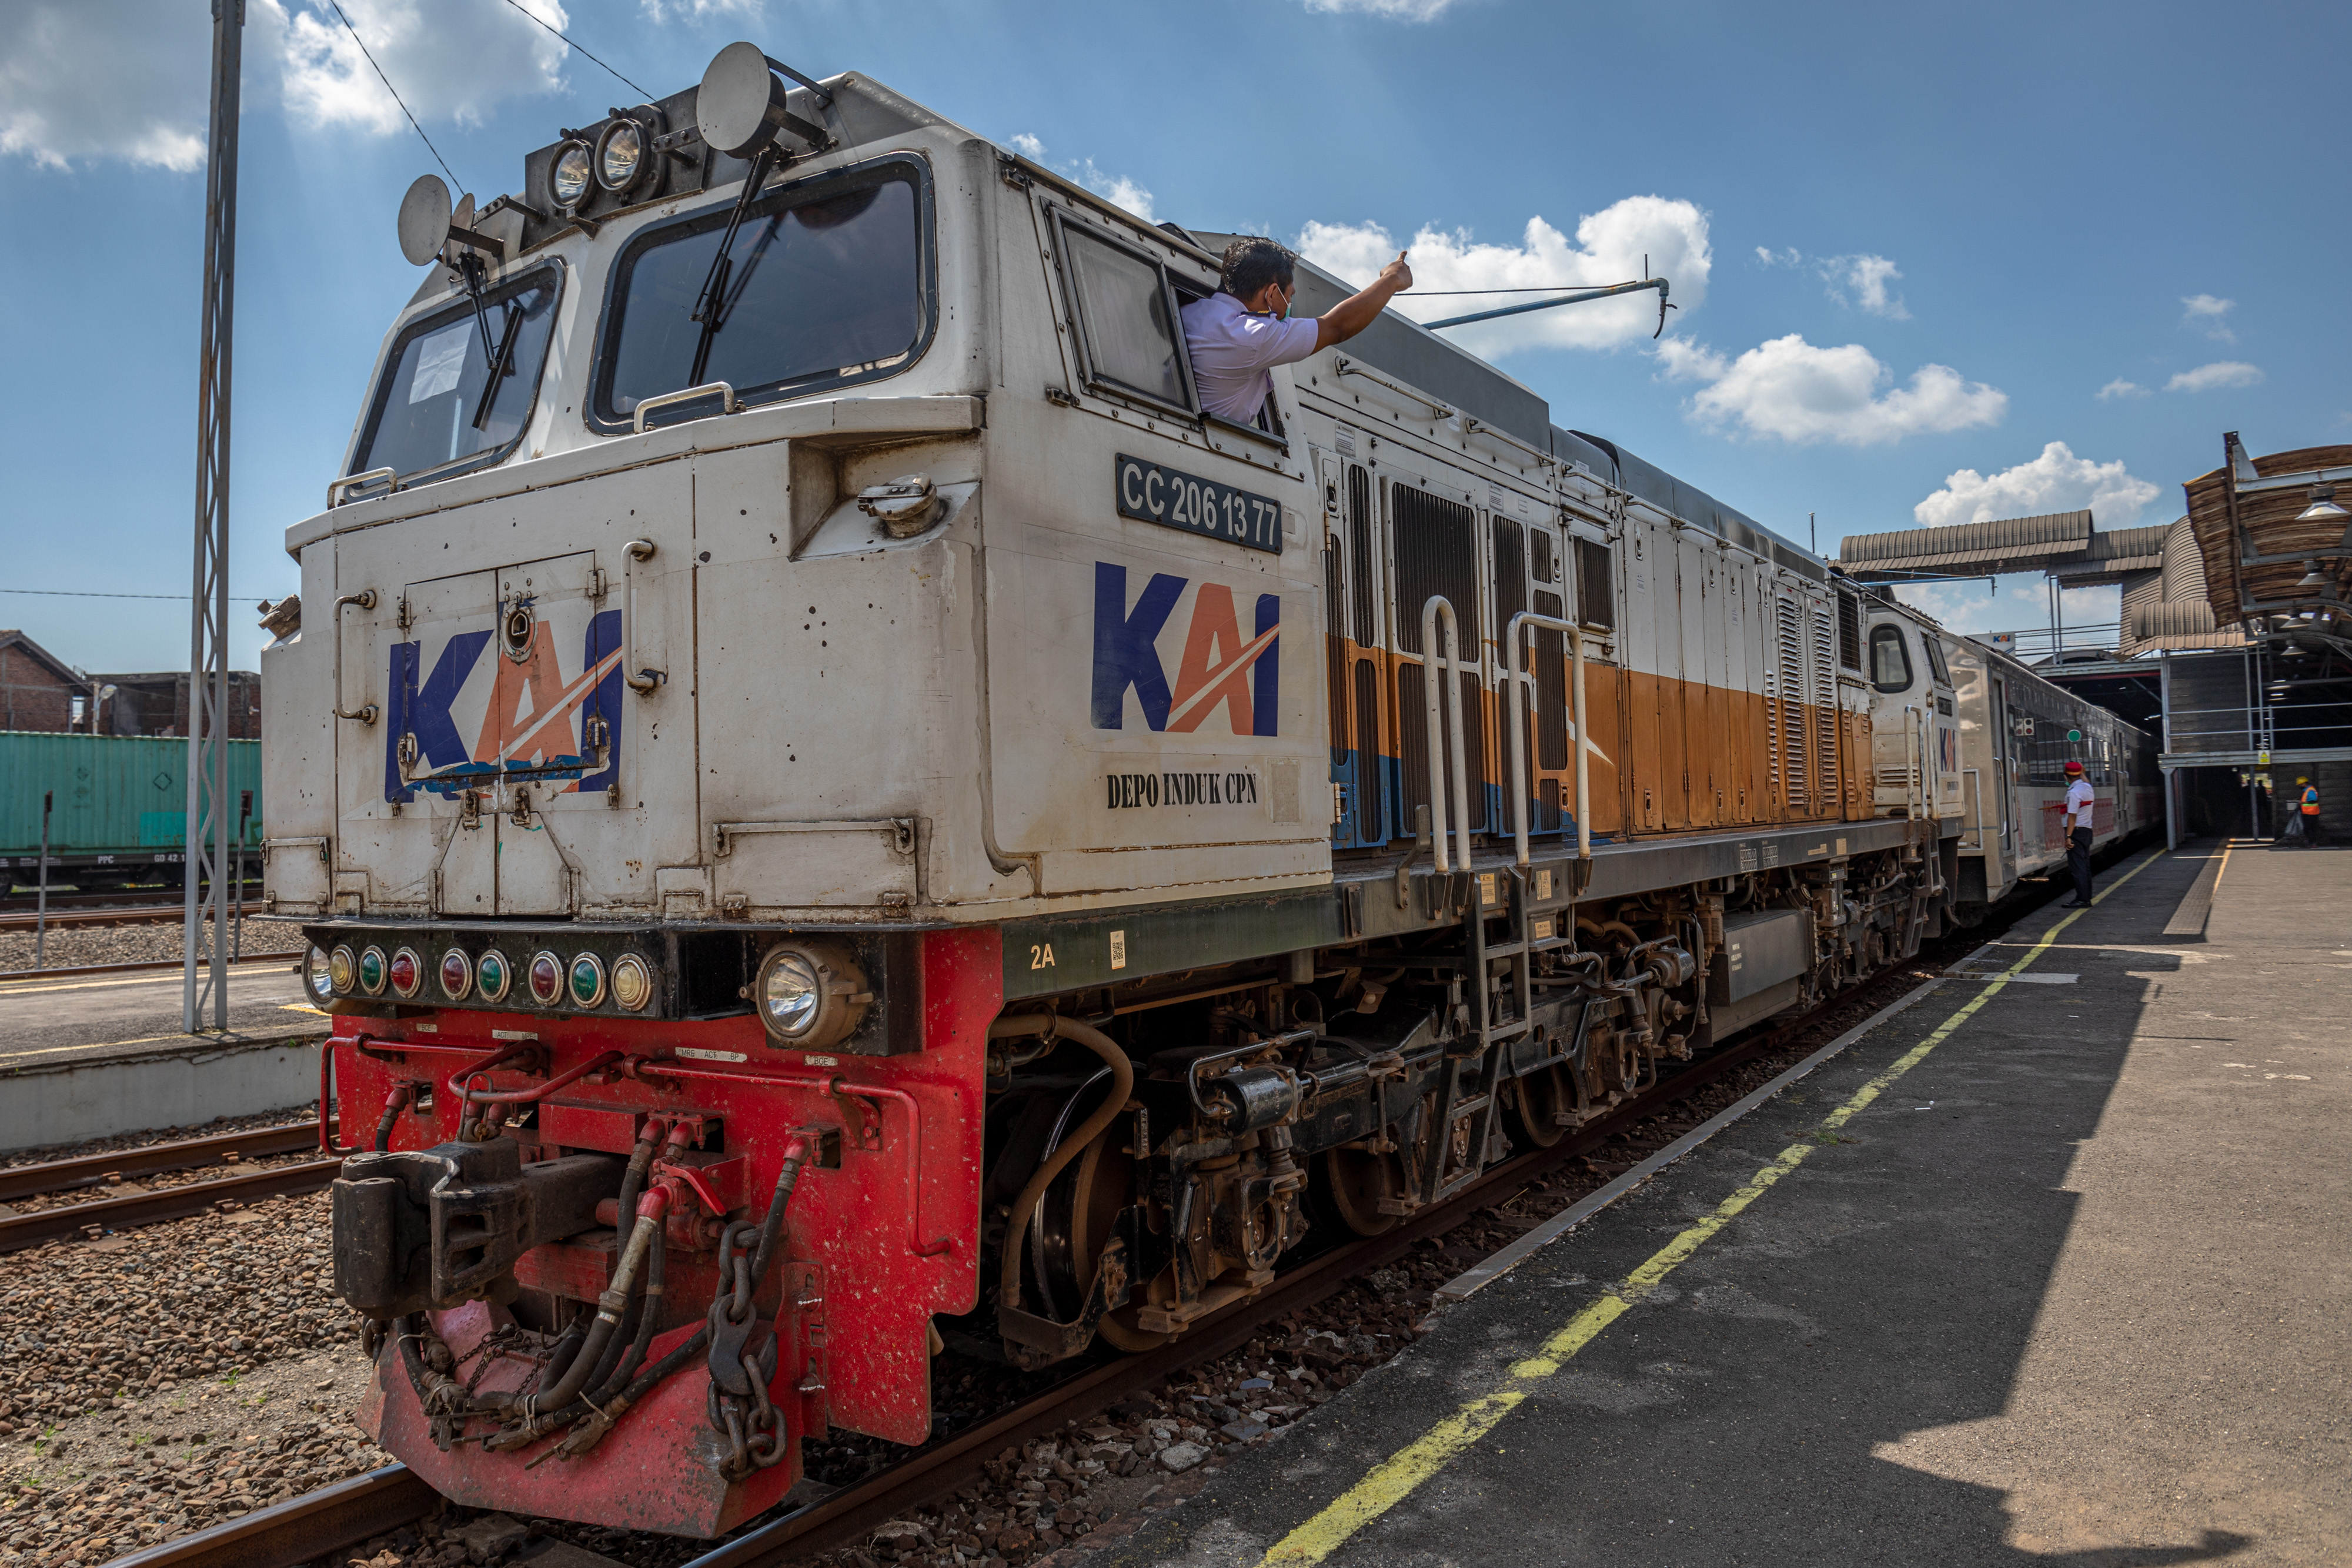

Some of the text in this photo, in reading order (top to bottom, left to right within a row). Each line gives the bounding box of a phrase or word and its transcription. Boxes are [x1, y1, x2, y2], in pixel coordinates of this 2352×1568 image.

[1123, 463, 1277, 546] CC 206 13 77
[1091, 561, 1279, 737] KAI
[385, 609, 623, 804] KAI
[1940, 727, 1956, 772] KAI
[1107, 773, 1257, 809] DEPO INDUK CPN
[98, 855, 113, 864] PPC
[168, 854, 178, 862] 42
[1031, 944, 1055, 969] 2A
[681, 1049, 694, 1057] MRE
